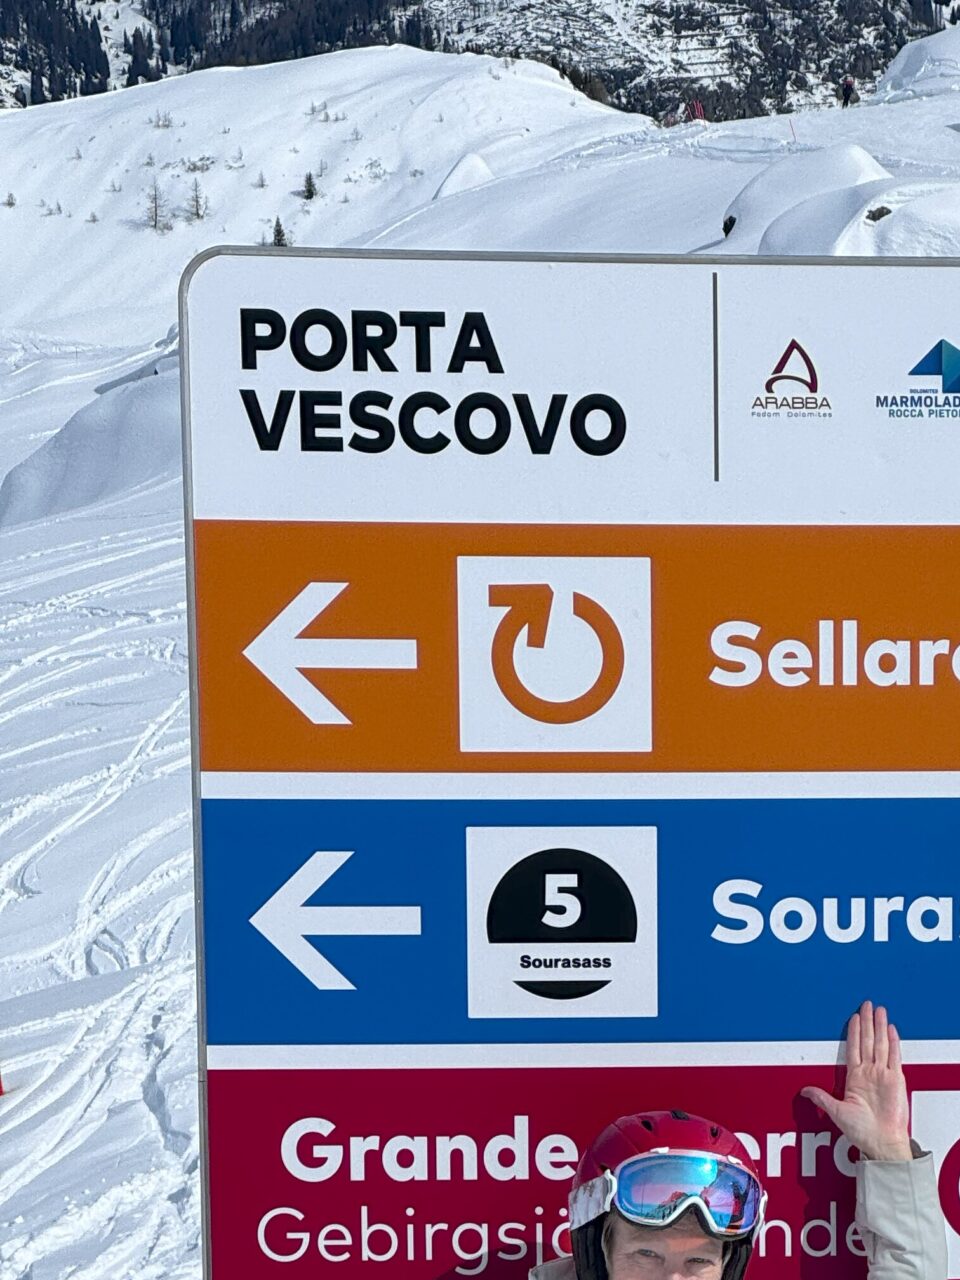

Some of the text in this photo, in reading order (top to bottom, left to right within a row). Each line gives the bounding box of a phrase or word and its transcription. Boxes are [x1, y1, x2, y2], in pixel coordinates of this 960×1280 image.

[240, 308, 505, 374] PORTA
[239, 389, 627, 457] VESCOVO
[752, 396, 832, 410] ARABBA
[888, 409, 924, 418] ROCCA
[541, 873, 582, 928] 5
[520, 955, 612, 969] Sourasass
[281, 1115, 579, 1183] Grande
